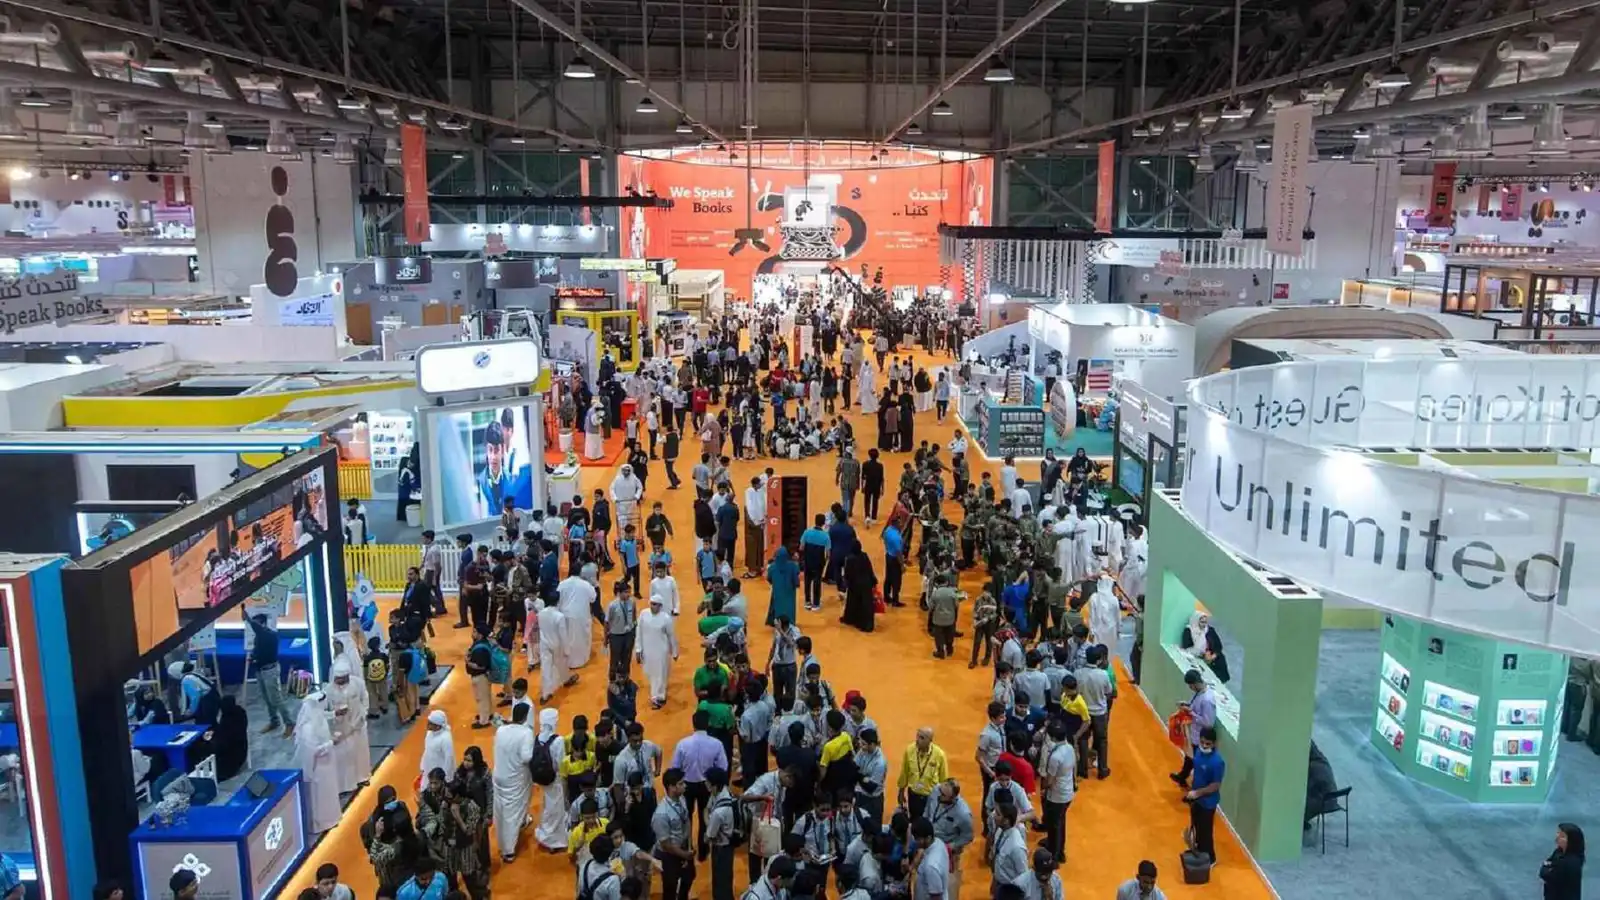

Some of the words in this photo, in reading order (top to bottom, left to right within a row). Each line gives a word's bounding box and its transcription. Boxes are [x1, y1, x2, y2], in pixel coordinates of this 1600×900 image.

[669, 186, 691, 199] We
[693, 186, 736, 202] Speak
[692, 202, 733, 213] Books
[53, 296, 103, 319] Books
[1215, 454, 1575, 607] Unlimited
